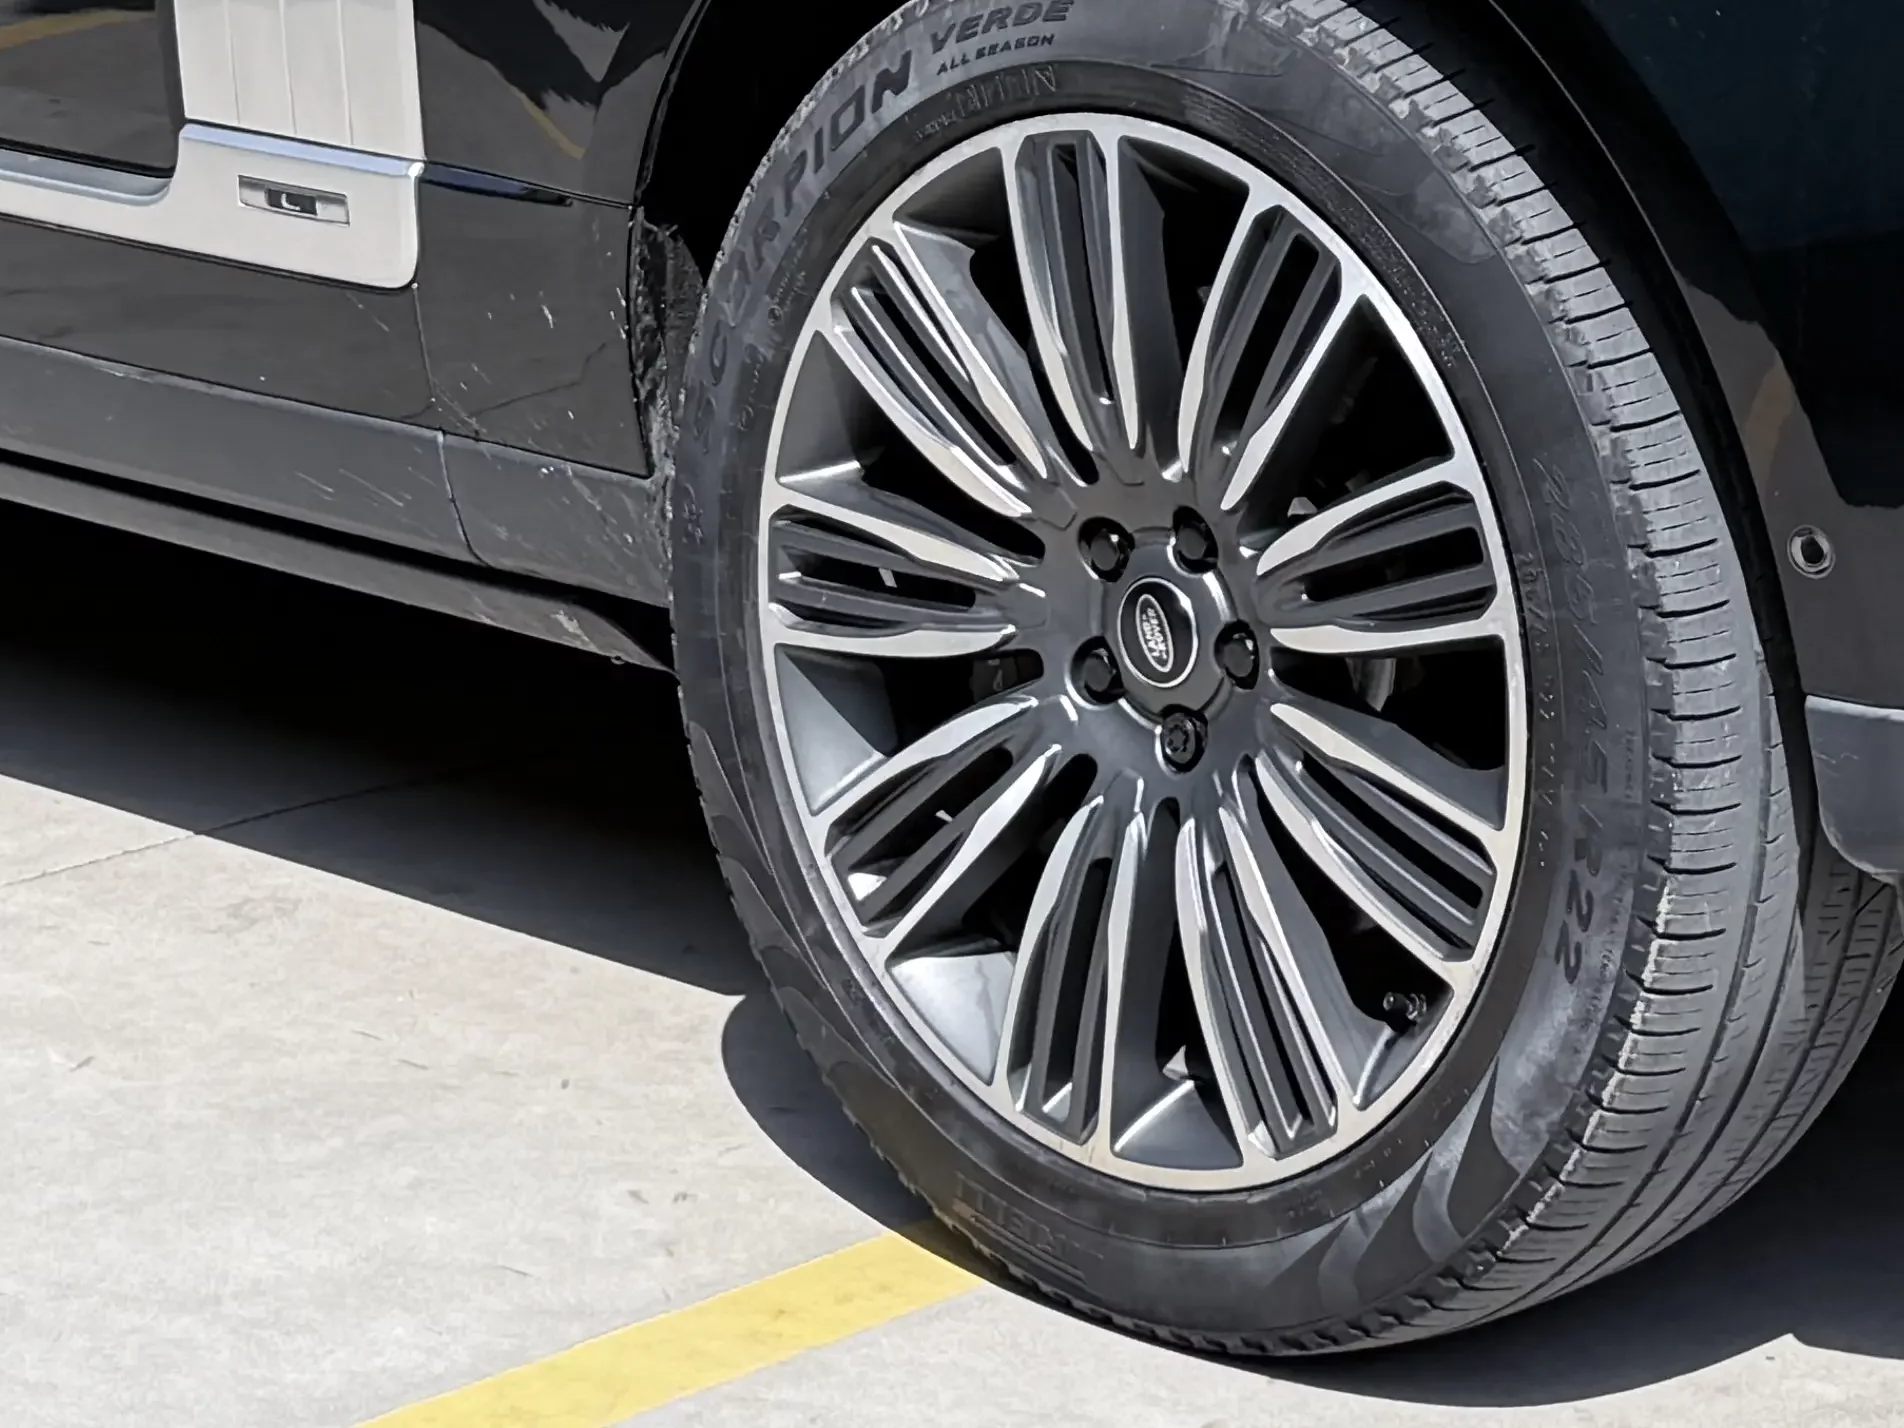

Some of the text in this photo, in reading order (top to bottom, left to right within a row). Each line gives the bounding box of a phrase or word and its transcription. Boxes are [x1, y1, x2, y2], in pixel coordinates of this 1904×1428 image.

[936, 33, 1055, 76] ALL SEASON
[281, 192, 301, 211] L
